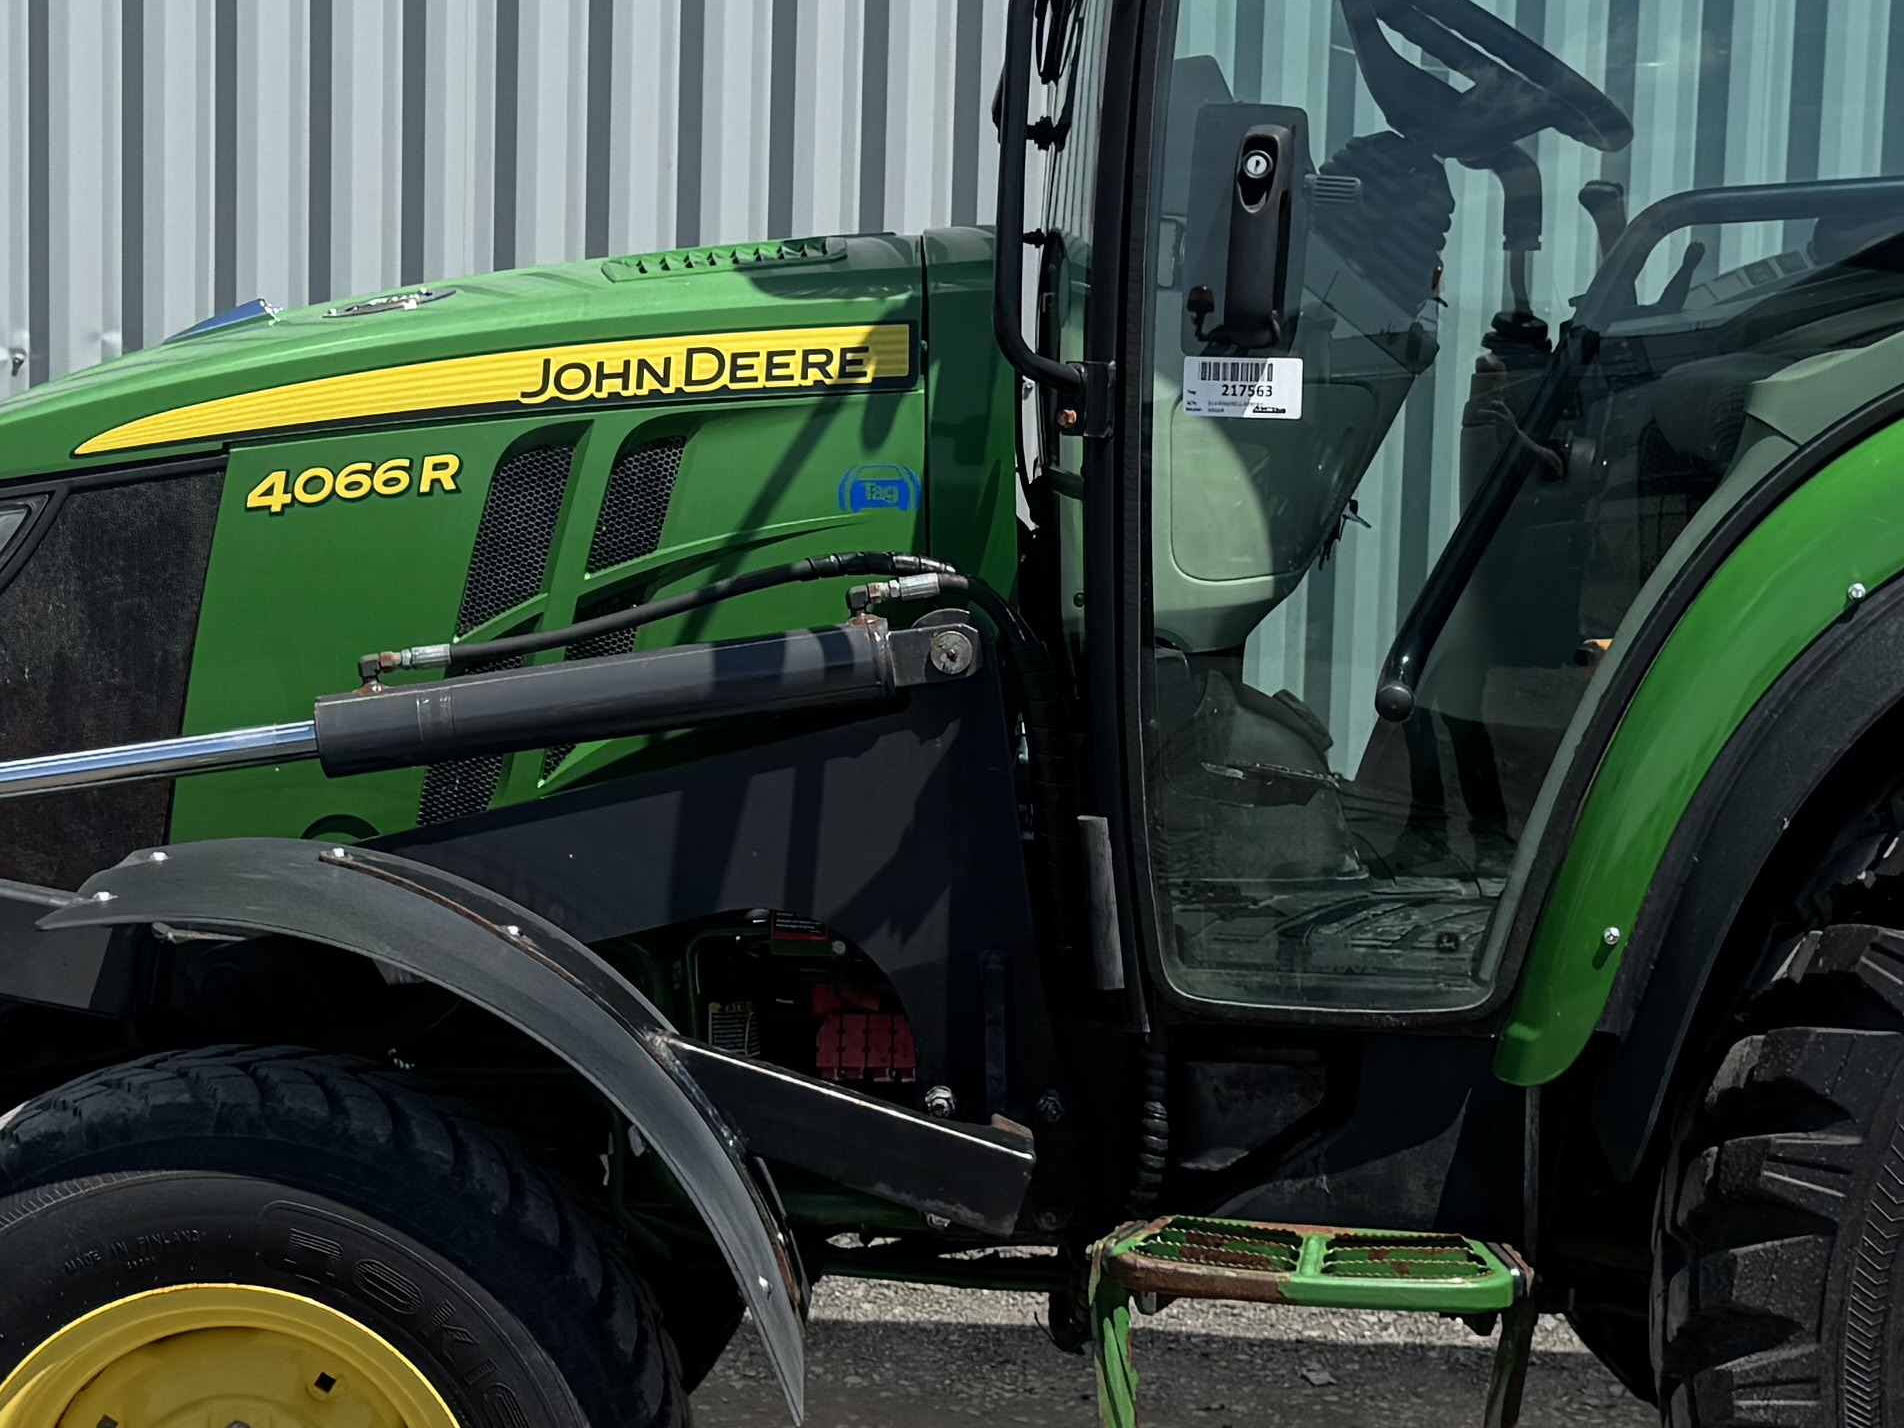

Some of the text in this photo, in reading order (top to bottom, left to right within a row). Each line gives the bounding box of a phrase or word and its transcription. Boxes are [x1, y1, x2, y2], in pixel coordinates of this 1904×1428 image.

[521, 345, 870, 399] JOHN DEERE
[1221, 384, 1273, 397] 217563
